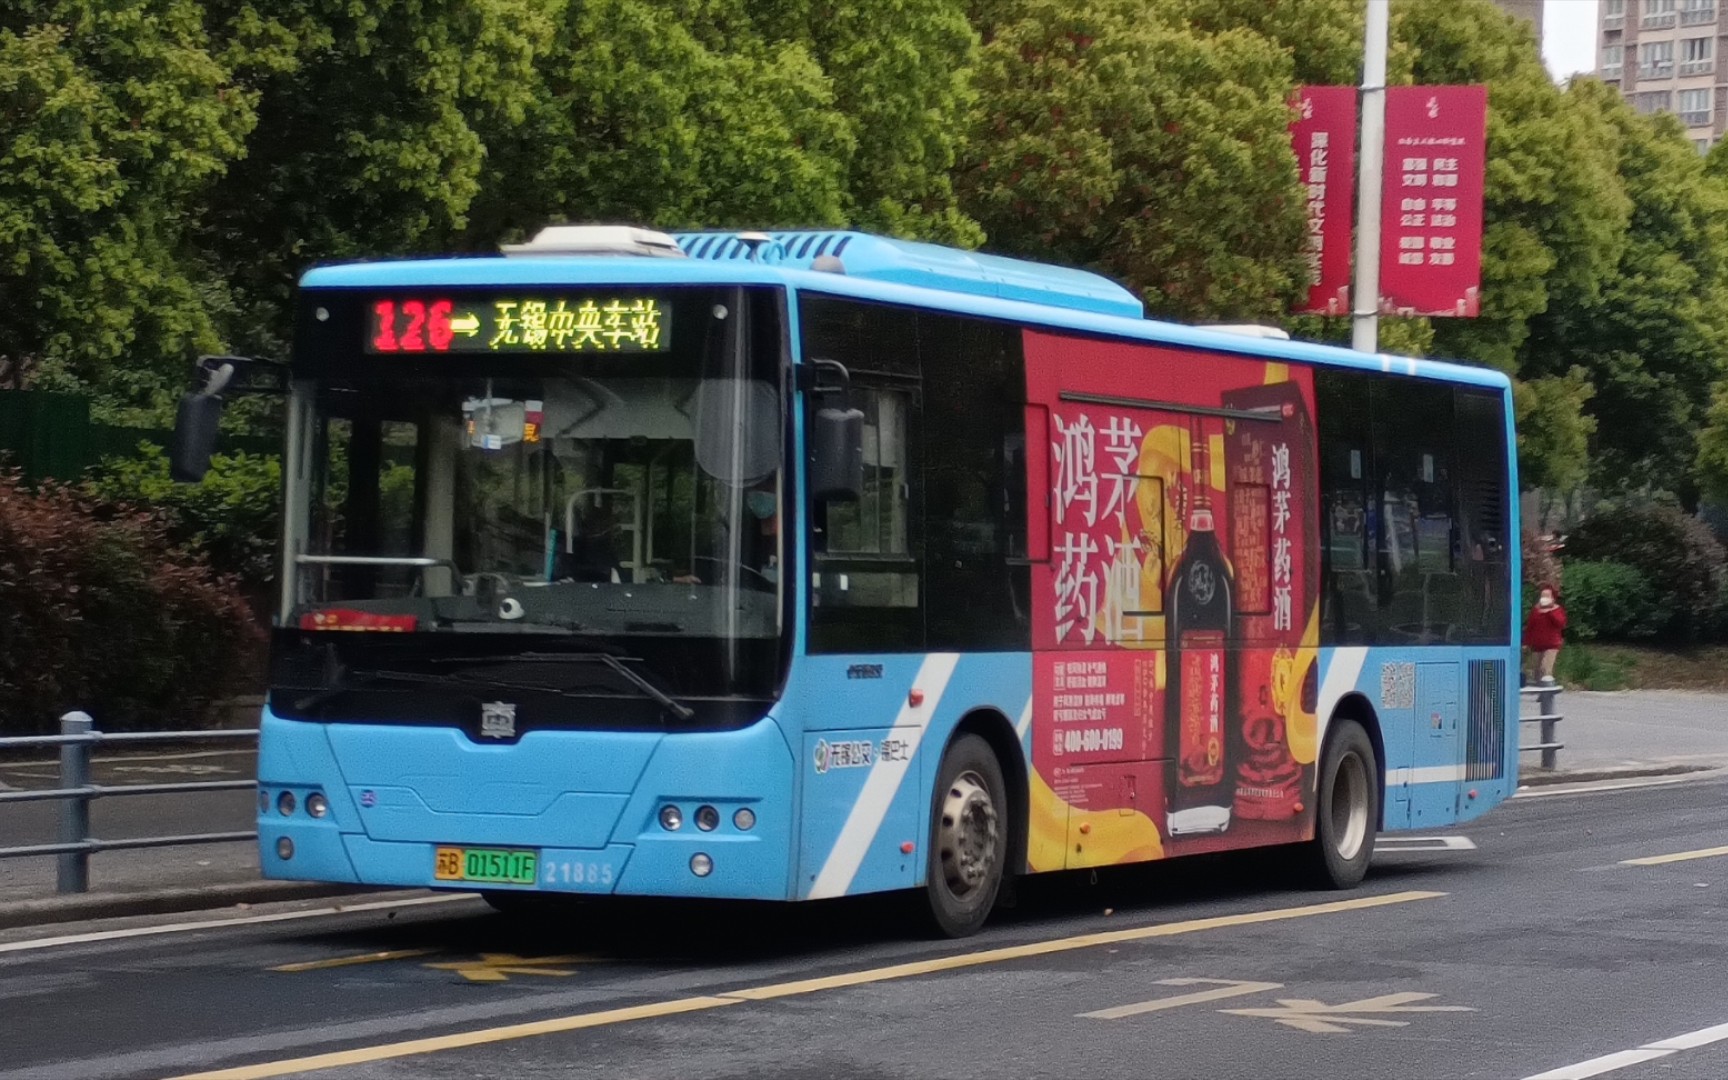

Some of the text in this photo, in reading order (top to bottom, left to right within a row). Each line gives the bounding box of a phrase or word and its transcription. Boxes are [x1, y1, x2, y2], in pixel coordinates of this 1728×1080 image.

[373, 301, 453, 350] 126
[1052, 413, 1142, 528] 鸿茅
[1053, 532, 1145, 646] 药酒
